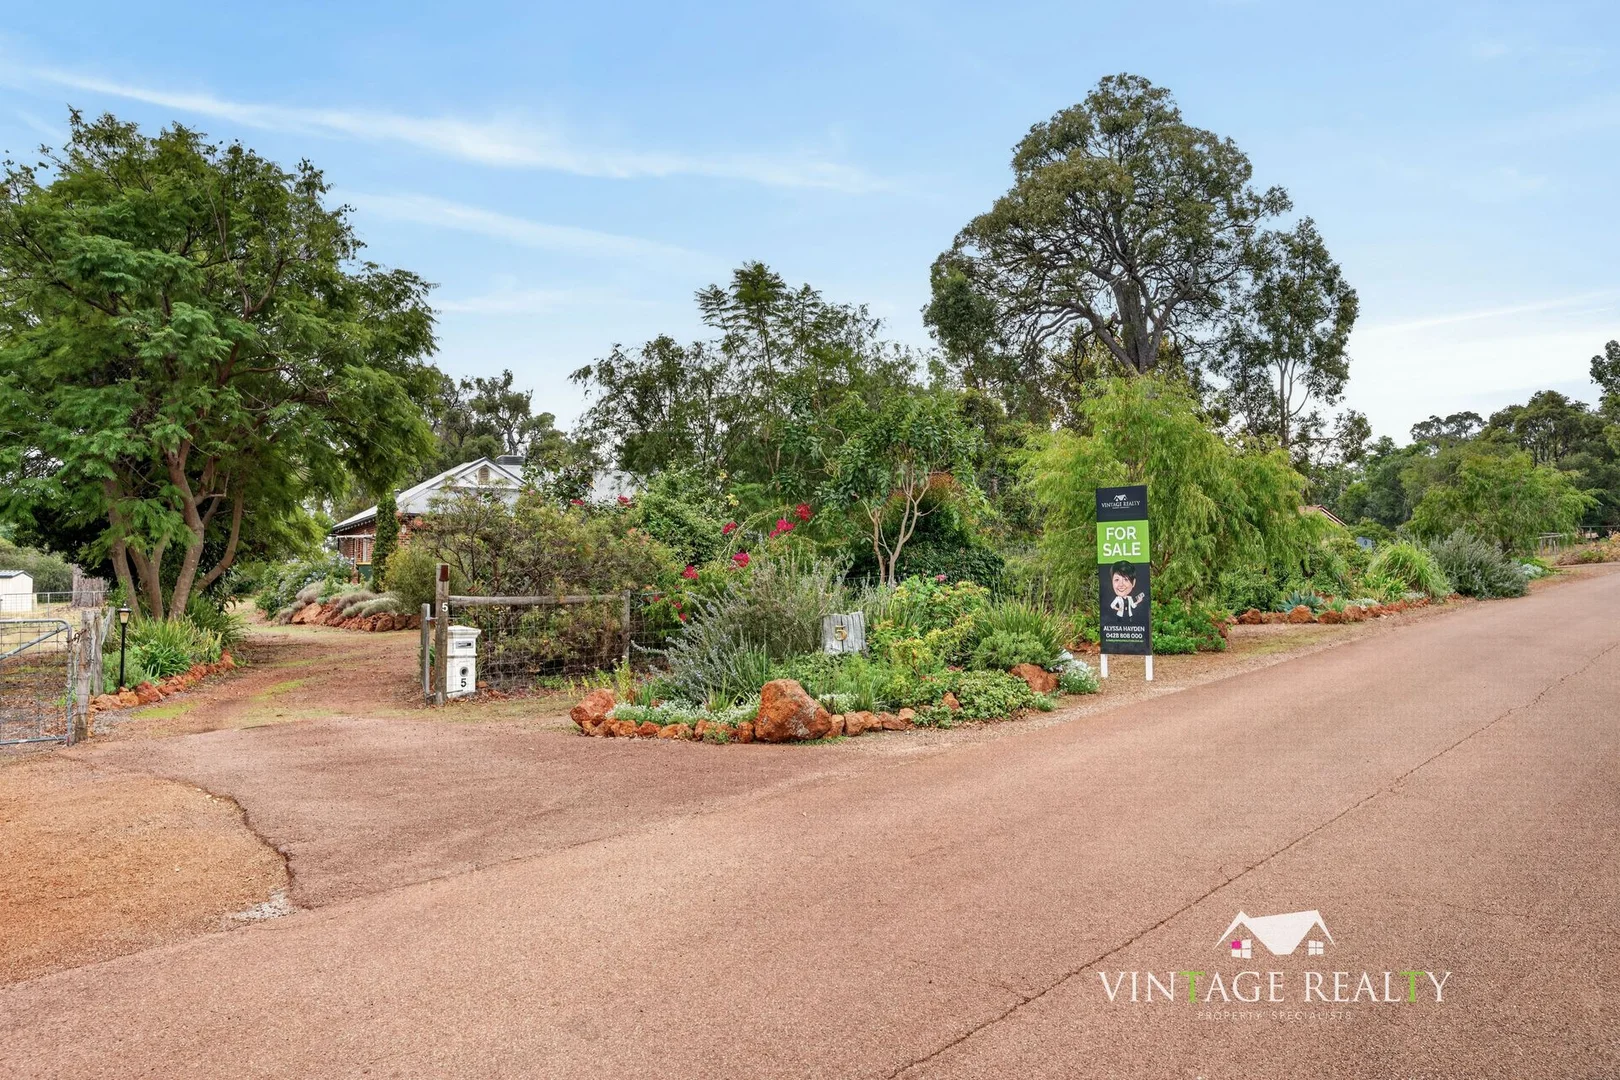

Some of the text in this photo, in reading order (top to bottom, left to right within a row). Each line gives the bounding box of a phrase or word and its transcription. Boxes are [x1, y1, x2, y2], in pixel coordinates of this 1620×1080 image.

[1106, 526, 1137, 540] FOR
[1103, 542, 1141, 557] SALE
[442, 602, 449, 612] 5
[834, 625, 848, 641] 5
[460, 678, 467, 688] 5
